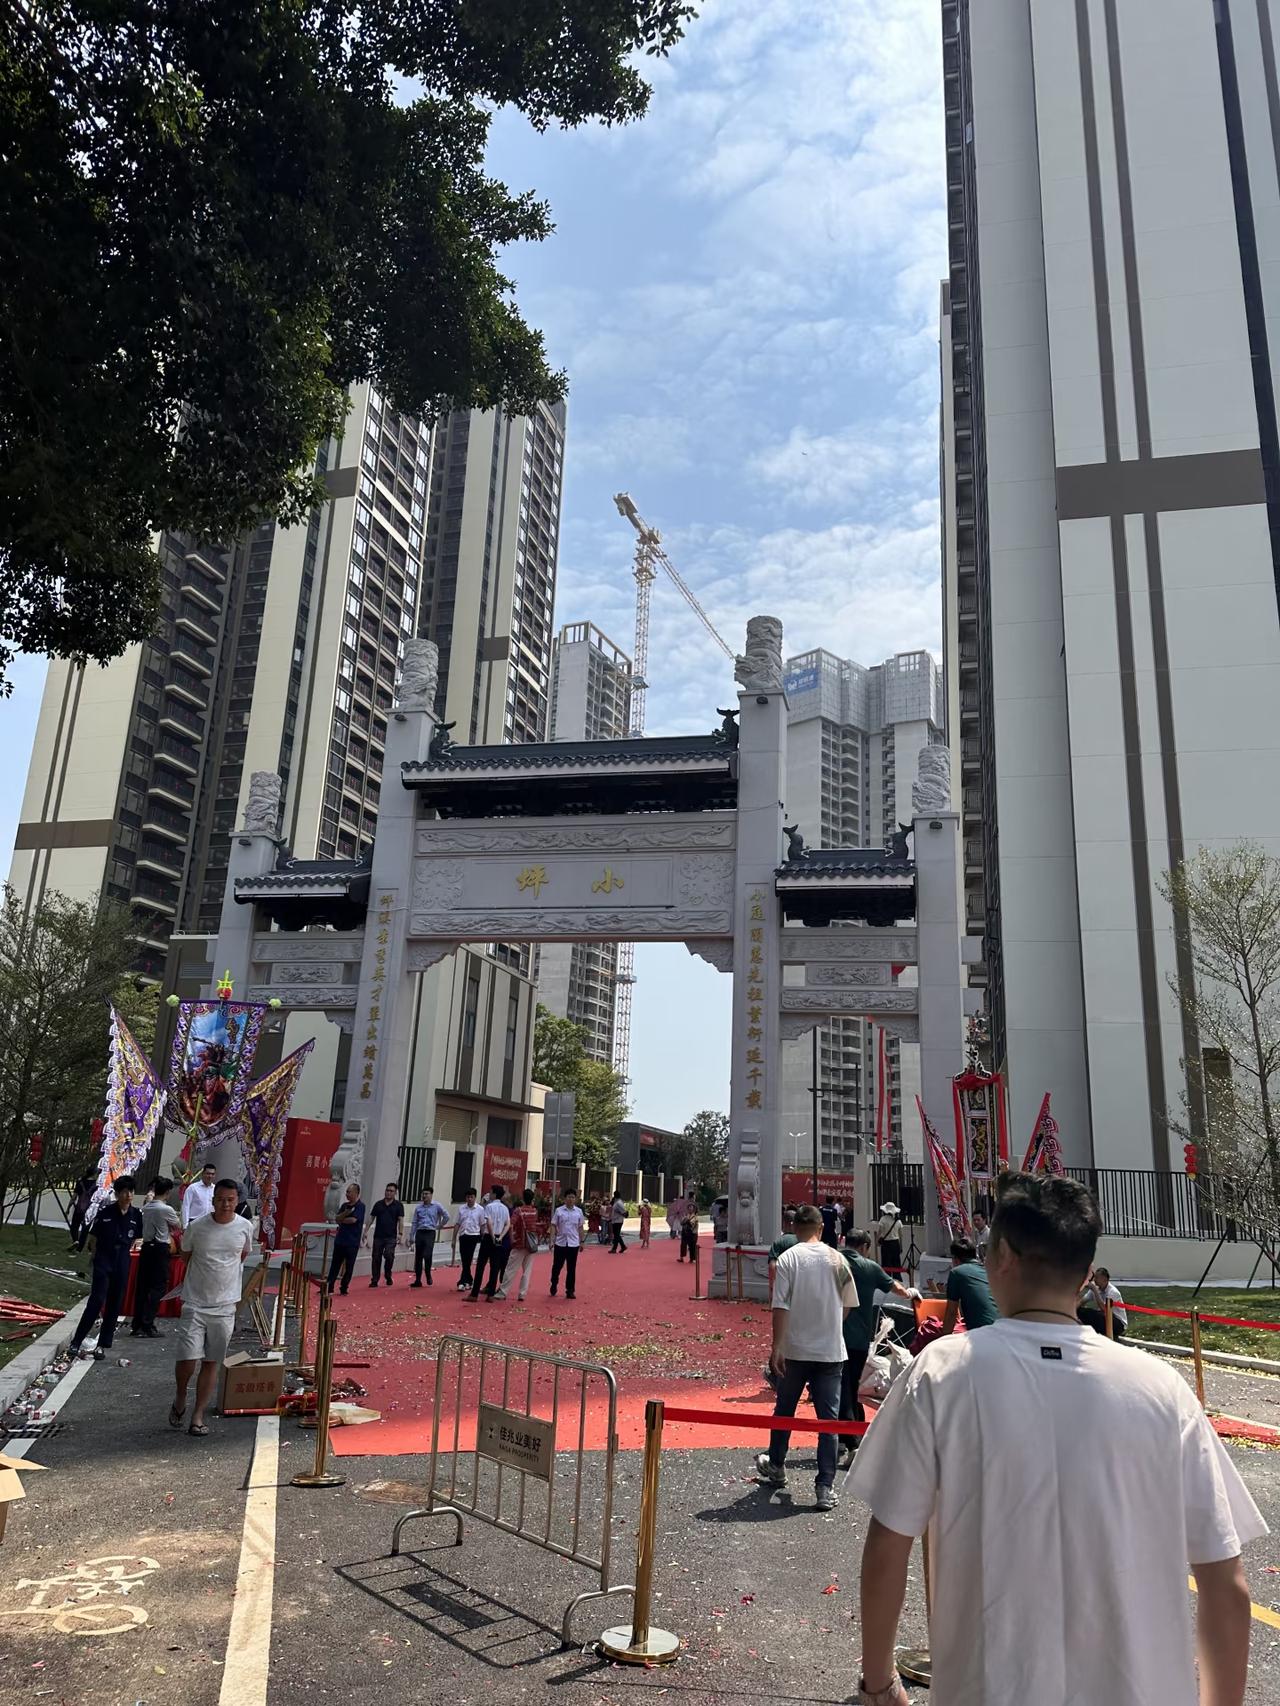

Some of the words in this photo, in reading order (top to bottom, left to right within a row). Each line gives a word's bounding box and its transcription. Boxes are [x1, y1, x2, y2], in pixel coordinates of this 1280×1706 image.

[500, 1425, 542, 1453] 佳兆业美好
